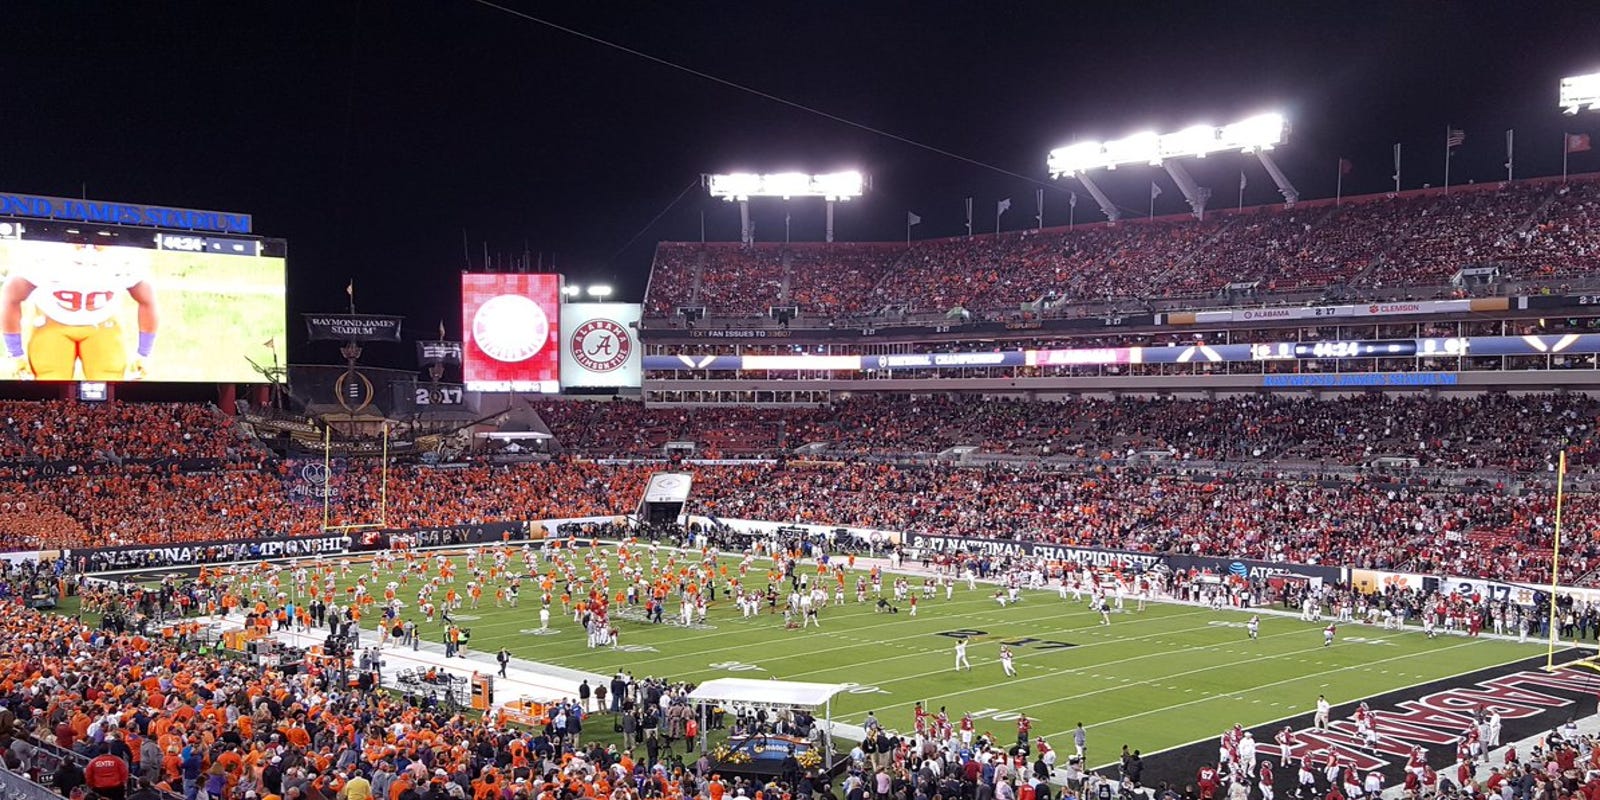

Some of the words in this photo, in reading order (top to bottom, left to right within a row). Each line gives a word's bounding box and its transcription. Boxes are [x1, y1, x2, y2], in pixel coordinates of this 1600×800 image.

[54, 200, 141, 224] JAMES
[145, 207, 248, 232] STADIUM
[1253, 310, 1290, 318] ALABAMA
[1380, 304, 1420, 313] CLEMSON
[312, 318, 362, 327] RAYMOND
[362, 319, 396, 328] JAMES
[331, 326, 374, 335] STADIUM
[575, 321, 628, 343] ALABAMA
[588, 335, 613, 356] A
[1312, 341, 1359, 358] 44:24
[574, 349, 610, 370] CRIMSON
[610, 349, 627, 366] TIDE
[1340, 374, 1387, 386] JAMES
[1389, 373, 1458, 385] STADIUM
[1249, 566, 1284, 578] AT&T
